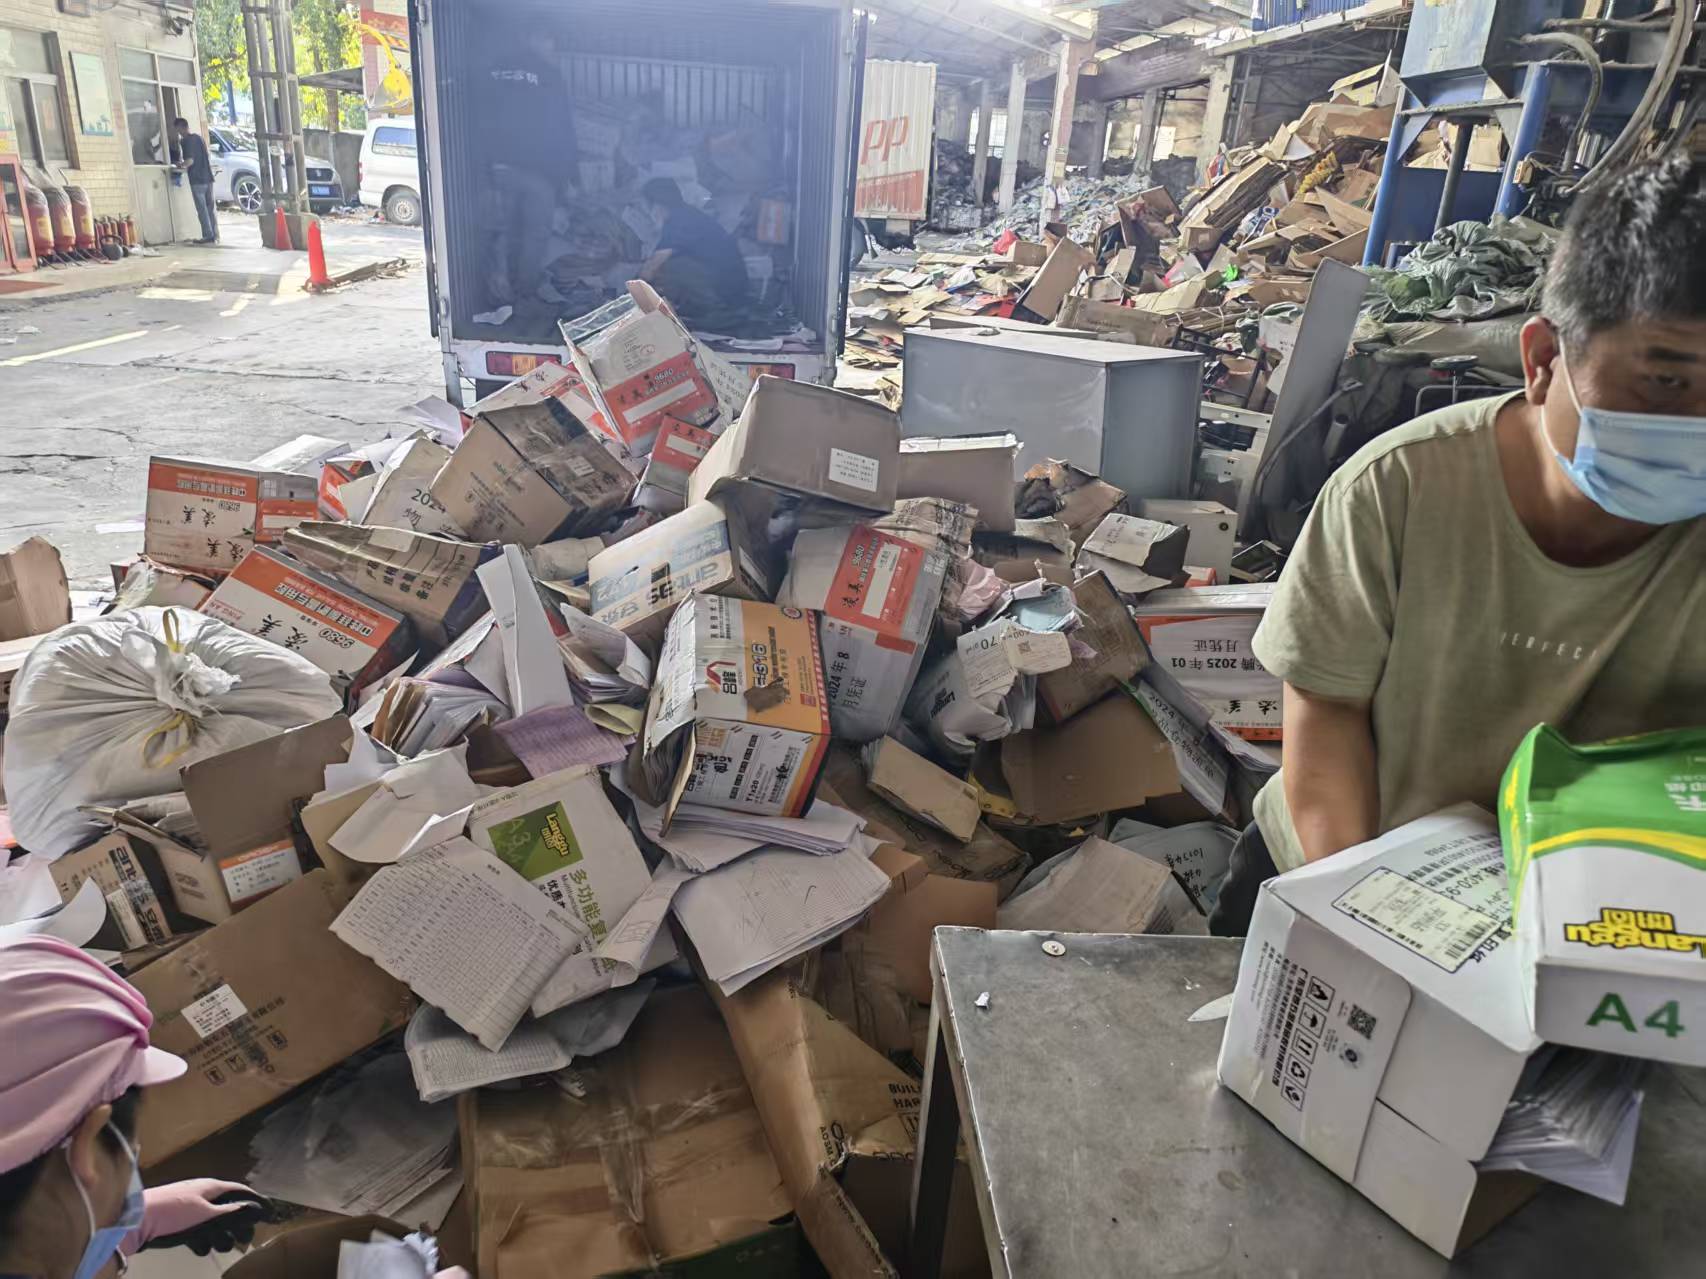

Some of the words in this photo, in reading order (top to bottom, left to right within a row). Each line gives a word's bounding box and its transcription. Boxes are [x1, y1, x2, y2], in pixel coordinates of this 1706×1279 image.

[852, 543, 865, 566] 9680
[257, 613, 309, 650] 凌美
[317, 627, 357, 649] 9680
[1192, 639, 1237, 653] 月凭证
[837, 650, 849, 659] 8
[830, 659, 847, 673] 年
[1171, 658, 1185, 666] 01
[1188, 657, 1202, 669] 年
[1206, 658, 1236, 668] 2025
[544, 811, 570, 856] Langgu
[1586, 991, 1686, 1039] A4
